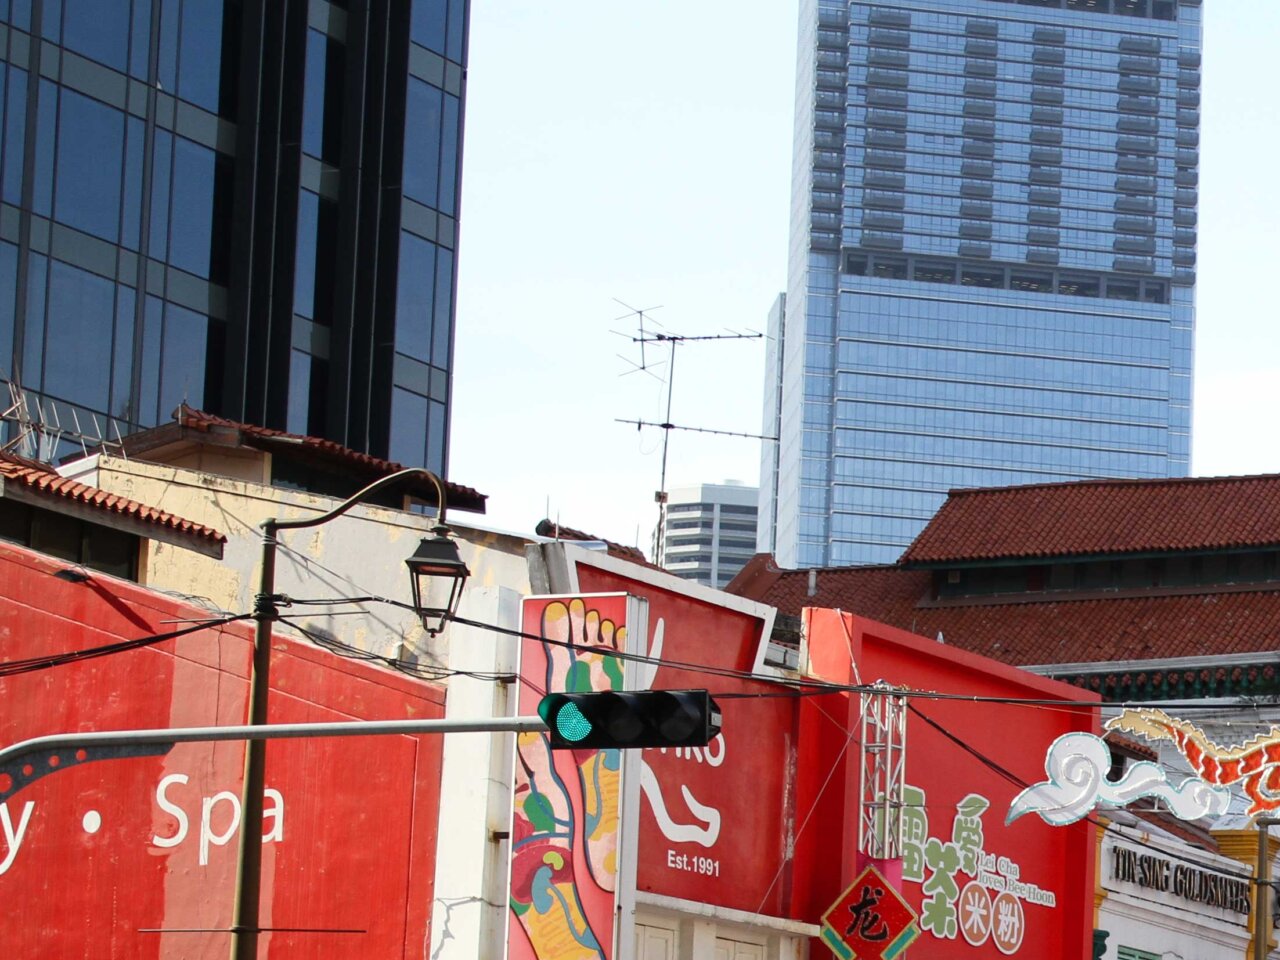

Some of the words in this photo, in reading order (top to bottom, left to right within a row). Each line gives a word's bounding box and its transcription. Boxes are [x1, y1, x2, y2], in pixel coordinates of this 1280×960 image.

[152, 774, 284, 865] Spa
[667, 849, 721, 877] Est.1991
[980, 853, 995, 870] Lei
[999, 859, 1019, 876] Cha
[978, 871, 1004, 889] loves
[1008, 879, 1026, 895] Bee
[1028, 885, 1055, 905] Hoon
